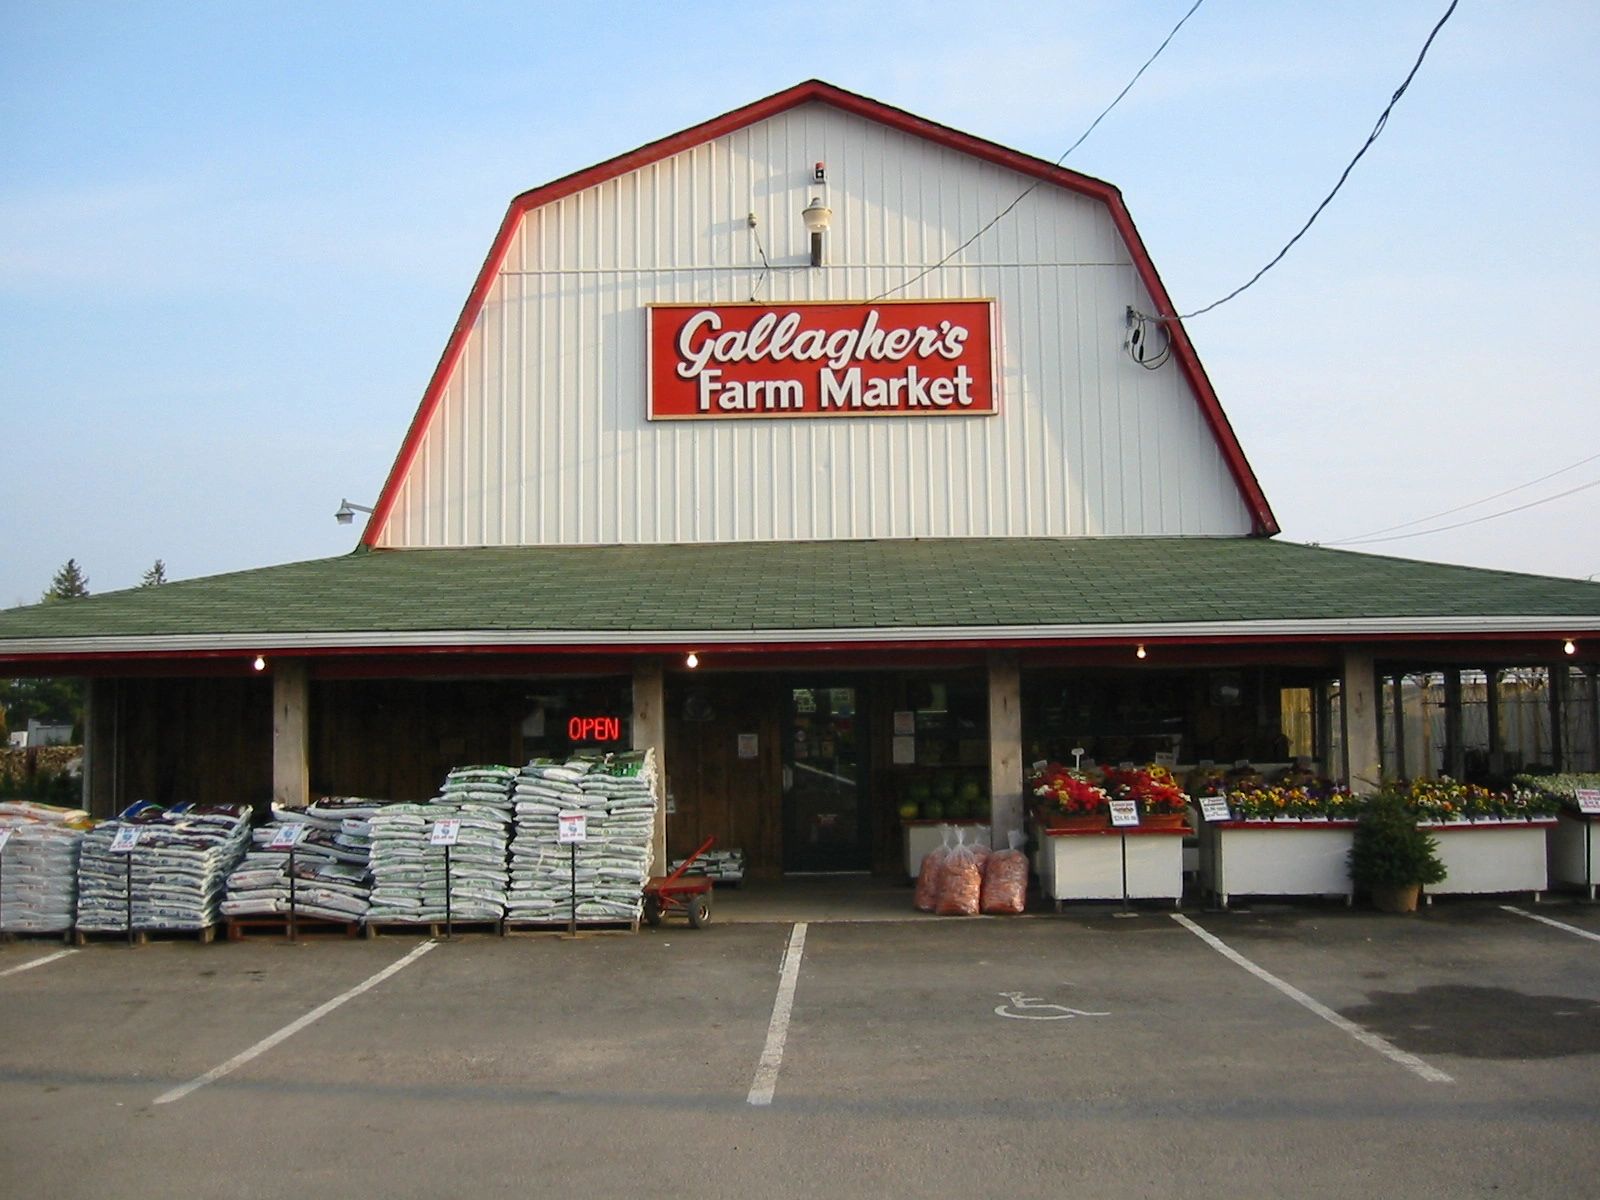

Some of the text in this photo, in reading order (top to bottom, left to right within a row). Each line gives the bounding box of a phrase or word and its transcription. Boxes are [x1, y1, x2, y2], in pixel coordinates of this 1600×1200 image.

[677, 310, 969, 378] Gallagher's
[699, 365, 973, 410] Farm Market
[569, 716, 619, 741] OPEN
